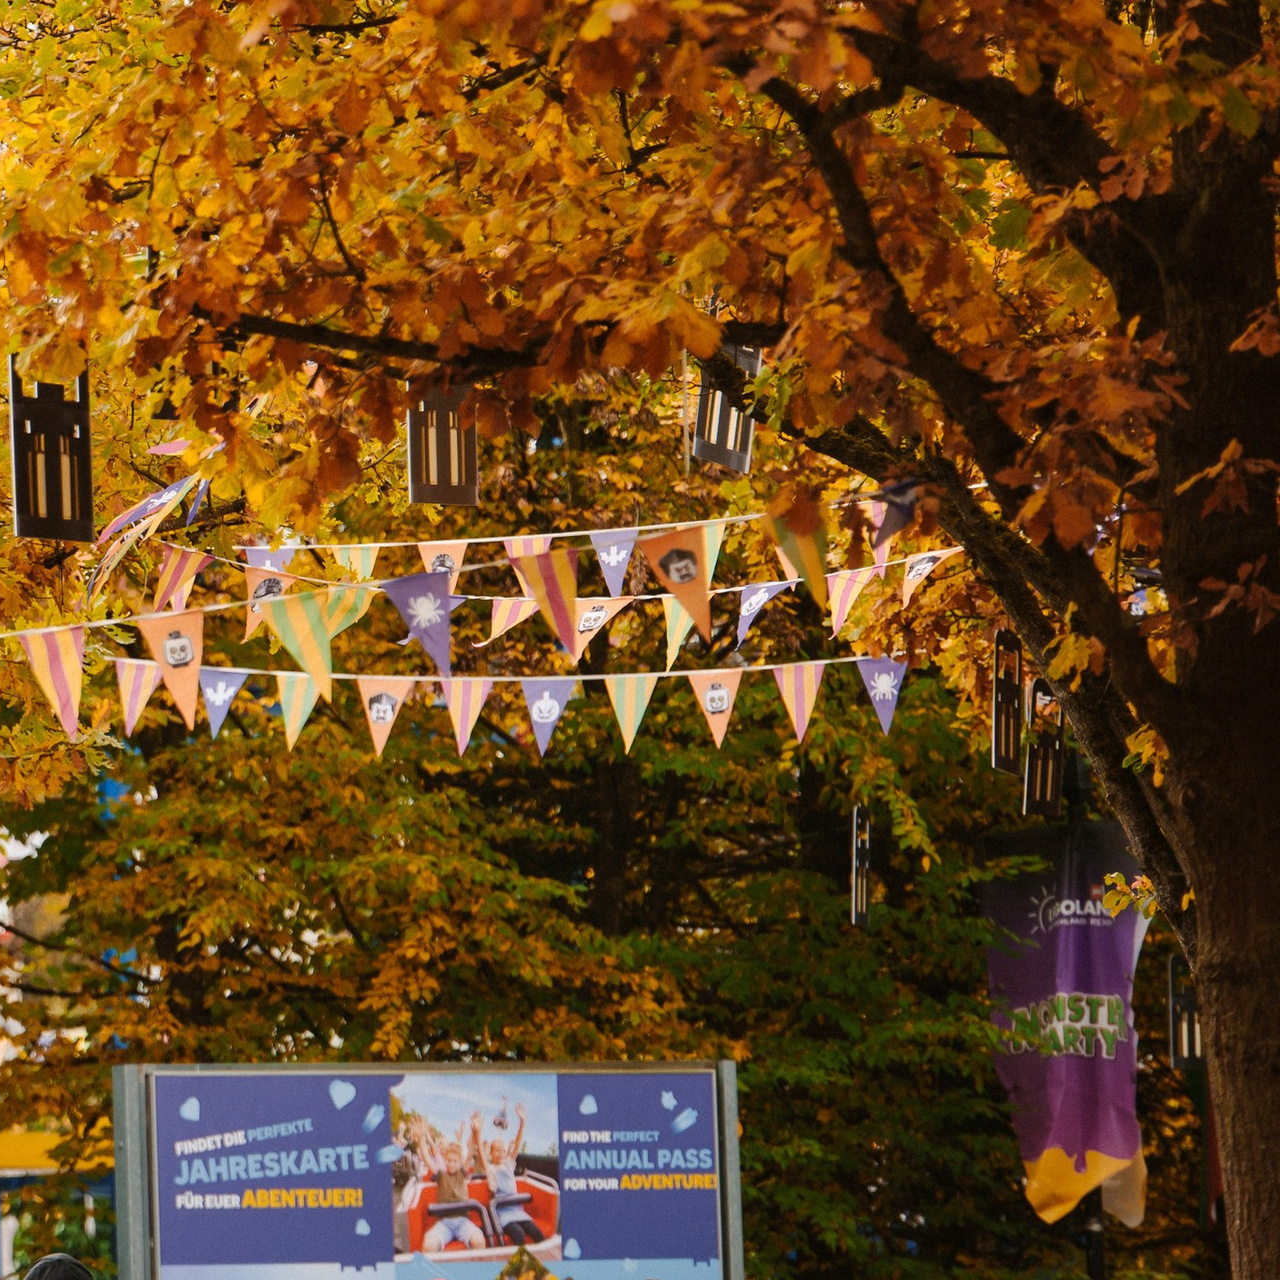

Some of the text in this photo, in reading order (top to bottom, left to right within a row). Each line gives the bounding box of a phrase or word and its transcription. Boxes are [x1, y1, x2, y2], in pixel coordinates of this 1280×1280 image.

[174, 1118, 314, 1157] FINDET DIE PERFEKTE
[562, 1130, 660, 1143] FIND THE PERFECT
[174, 1144, 370, 1185] JAHRESKARTE
[564, 1148, 713, 1170] ANNUAL PASS
[563, 1178, 587, 1191] FOR
[588, 1178, 619, 1191] YOUR
[175, 1187, 364, 1209] FÜR EUER ABENTEUER!
